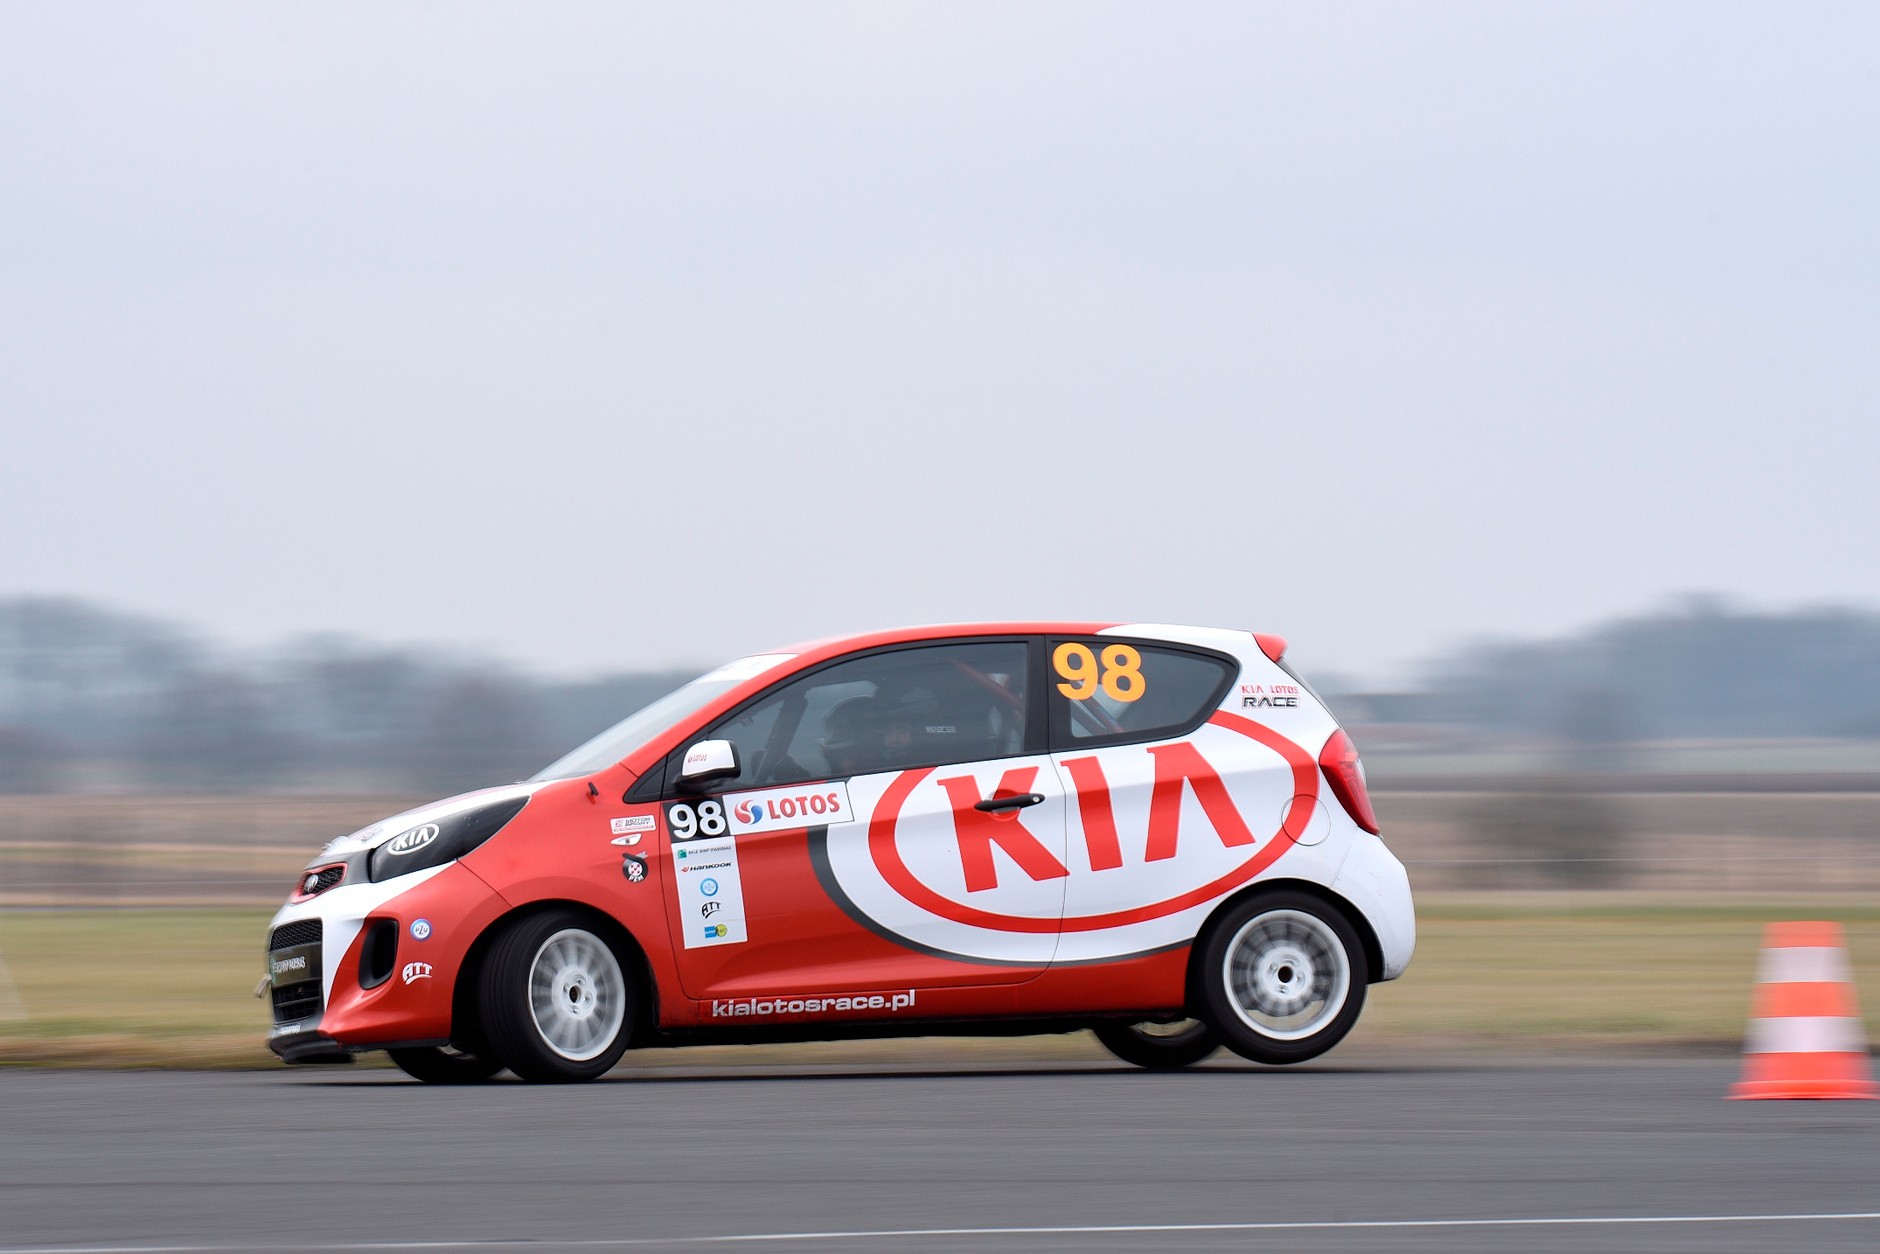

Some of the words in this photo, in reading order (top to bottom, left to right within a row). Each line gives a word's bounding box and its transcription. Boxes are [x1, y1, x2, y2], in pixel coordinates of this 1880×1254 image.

[1053, 642, 1146, 702] 98
[1241, 685, 1264, 694] KIA
[1270, 685, 1299, 694] LOTOS
[1243, 696, 1298, 708] RACE
[767, 792, 841, 820] LOTOS
[937, 741, 1256, 893] KIA
[668, 800, 727, 839] 98
[395, 827, 431, 851] KIA
[701, 901, 722, 917] ATT
[415, 925, 429, 935] PZU
[402, 962, 433, 983] ATT
[712, 989, 916, 1017] kialotosrace.pl
